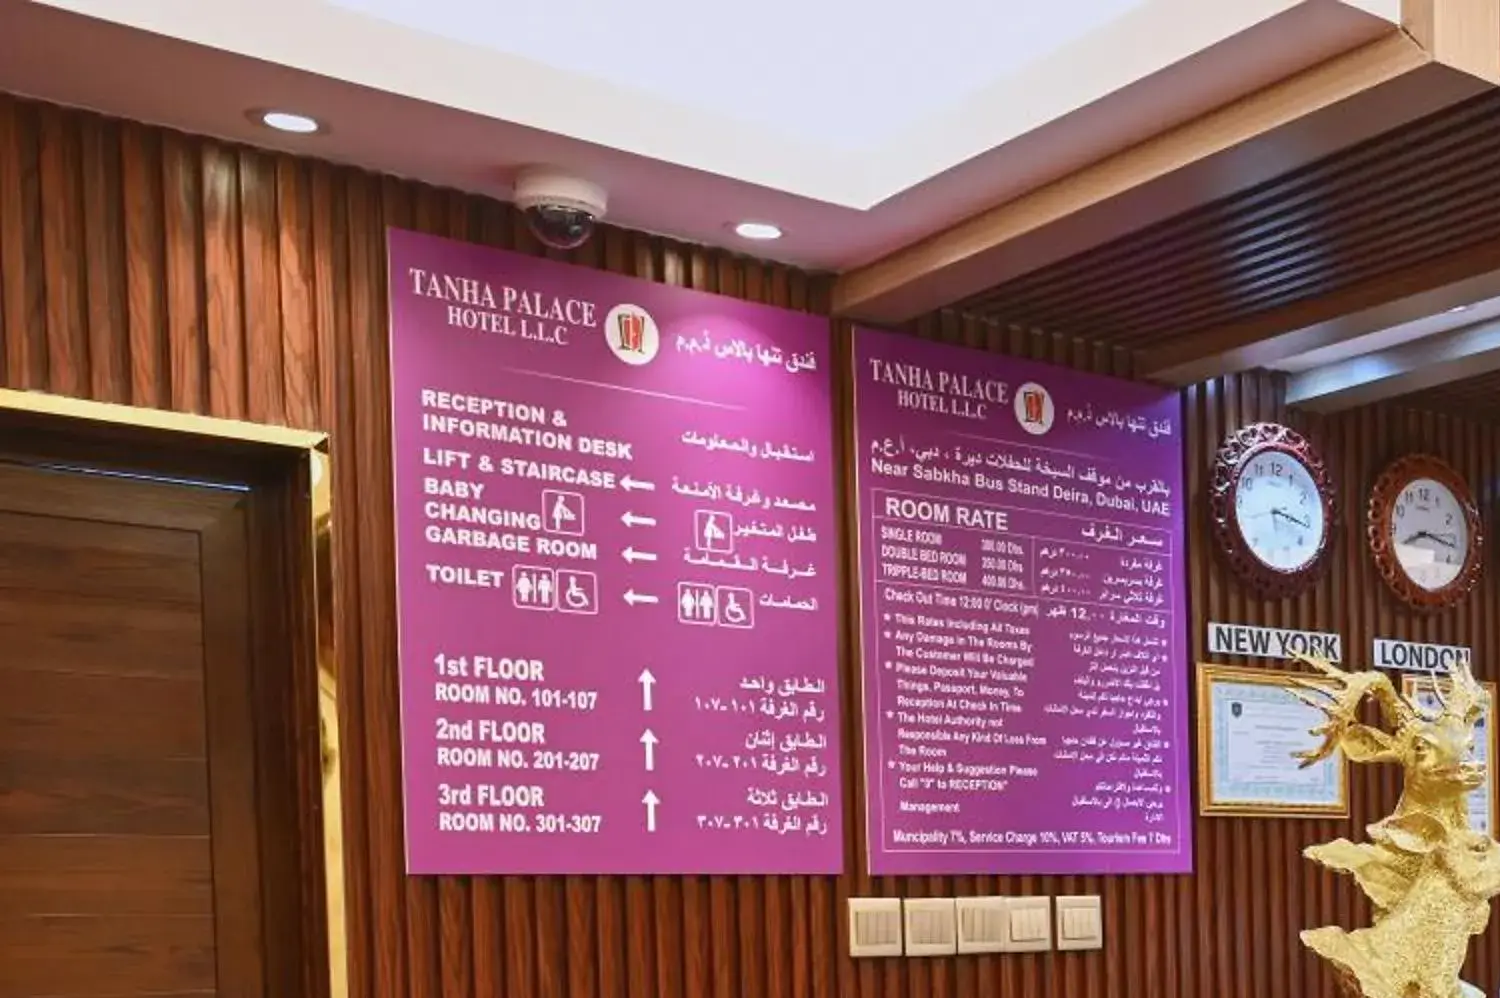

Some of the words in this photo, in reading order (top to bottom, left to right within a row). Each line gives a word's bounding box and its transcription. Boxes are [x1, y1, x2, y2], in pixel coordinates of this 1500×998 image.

[410, 268, 496, 308] TANHA
[503, 286, 597, 327] PALACE
[448, 306, 516, 335] HOTEL
[785, 351, 817, 372] فندق
[869, 358, 934, 391] TANHA
[938, 370, 1009, 405] PALACE
[421, 389, 545, 424] RECEPTION
[552, 410, 567, 427] &
[898, 389, 948, 414] HOTEL
[423, 413, 572, 451] INFORMATION
[578, 437, 633, 460] DESK
[423, 448, 471, 469] LIFT
[478, 455, 494, 472] &
[500, 457, 616, 489] STAIRCASE
[1271, 462, 1283, 476] 12
[423, 477, 485, 499] BABY
[871, 457, 908, 477] Near
[913, 464, 970, 486] Sabkha
[975, 473, 1004, 491] Bus
[1008, 478, 1049, 498] Stand
[1053, 485, 1093, 507] Deira,
[1142, 500, 1171, 517] UAE
[424, 501, 541, 531] CHANGING
[886, 497, 950, 524] ROOM
[956, 506, 1009, 531] RATE
[425, 525, 530, 553] GARBAGE
[536, 537, 597, 560] ROOM
[881, 525, 913, 543] SINGLE
[915, 529, 943, 546] ROOM
[881, 544, 919, 561] DOUBLE
[940, 551, 967, 567] ROOM
[425, 564, 504, 588] TOILET
[941, 569, 967, 584] ROOM
[885, 587, 914, 603] Check
[916, 591, 933, 605] Out
[896, 645, 914, 657] The
[1215, 626, 1270, 654] NEW
[1275, 632, 1338, 660] YORK
[434, 653, 468, 677] 1st
[473, 655, 545, 682] FLOOR
[1381, 642, 1469, 670] LONDON
[435, 682, 489, 704] ROOM
[495, 686, 527, 706] NO.
[531, 688, 598, 710] 101-107
[760, 697, 799, 720] الغرفة
[435, 717, 473, 741] 2nd
[479, 719, 546, 744] FLOOR
[437, 747, 492, 768] ROOM
[497, 749, 529, 769] NO.
[533, 751, 600, 771] 201-207
[761, 753, 800, 775] الغرفة
[438, 783, 472, 806] 3rd
[477, 785, 545, 807] FLOOR
[439, 812, 494, 832] ROOM
[499, 813, 531, 832] NO.
[535, 814, 602, 833] 301-307
[763, 812, 801, 835] الغرفة
